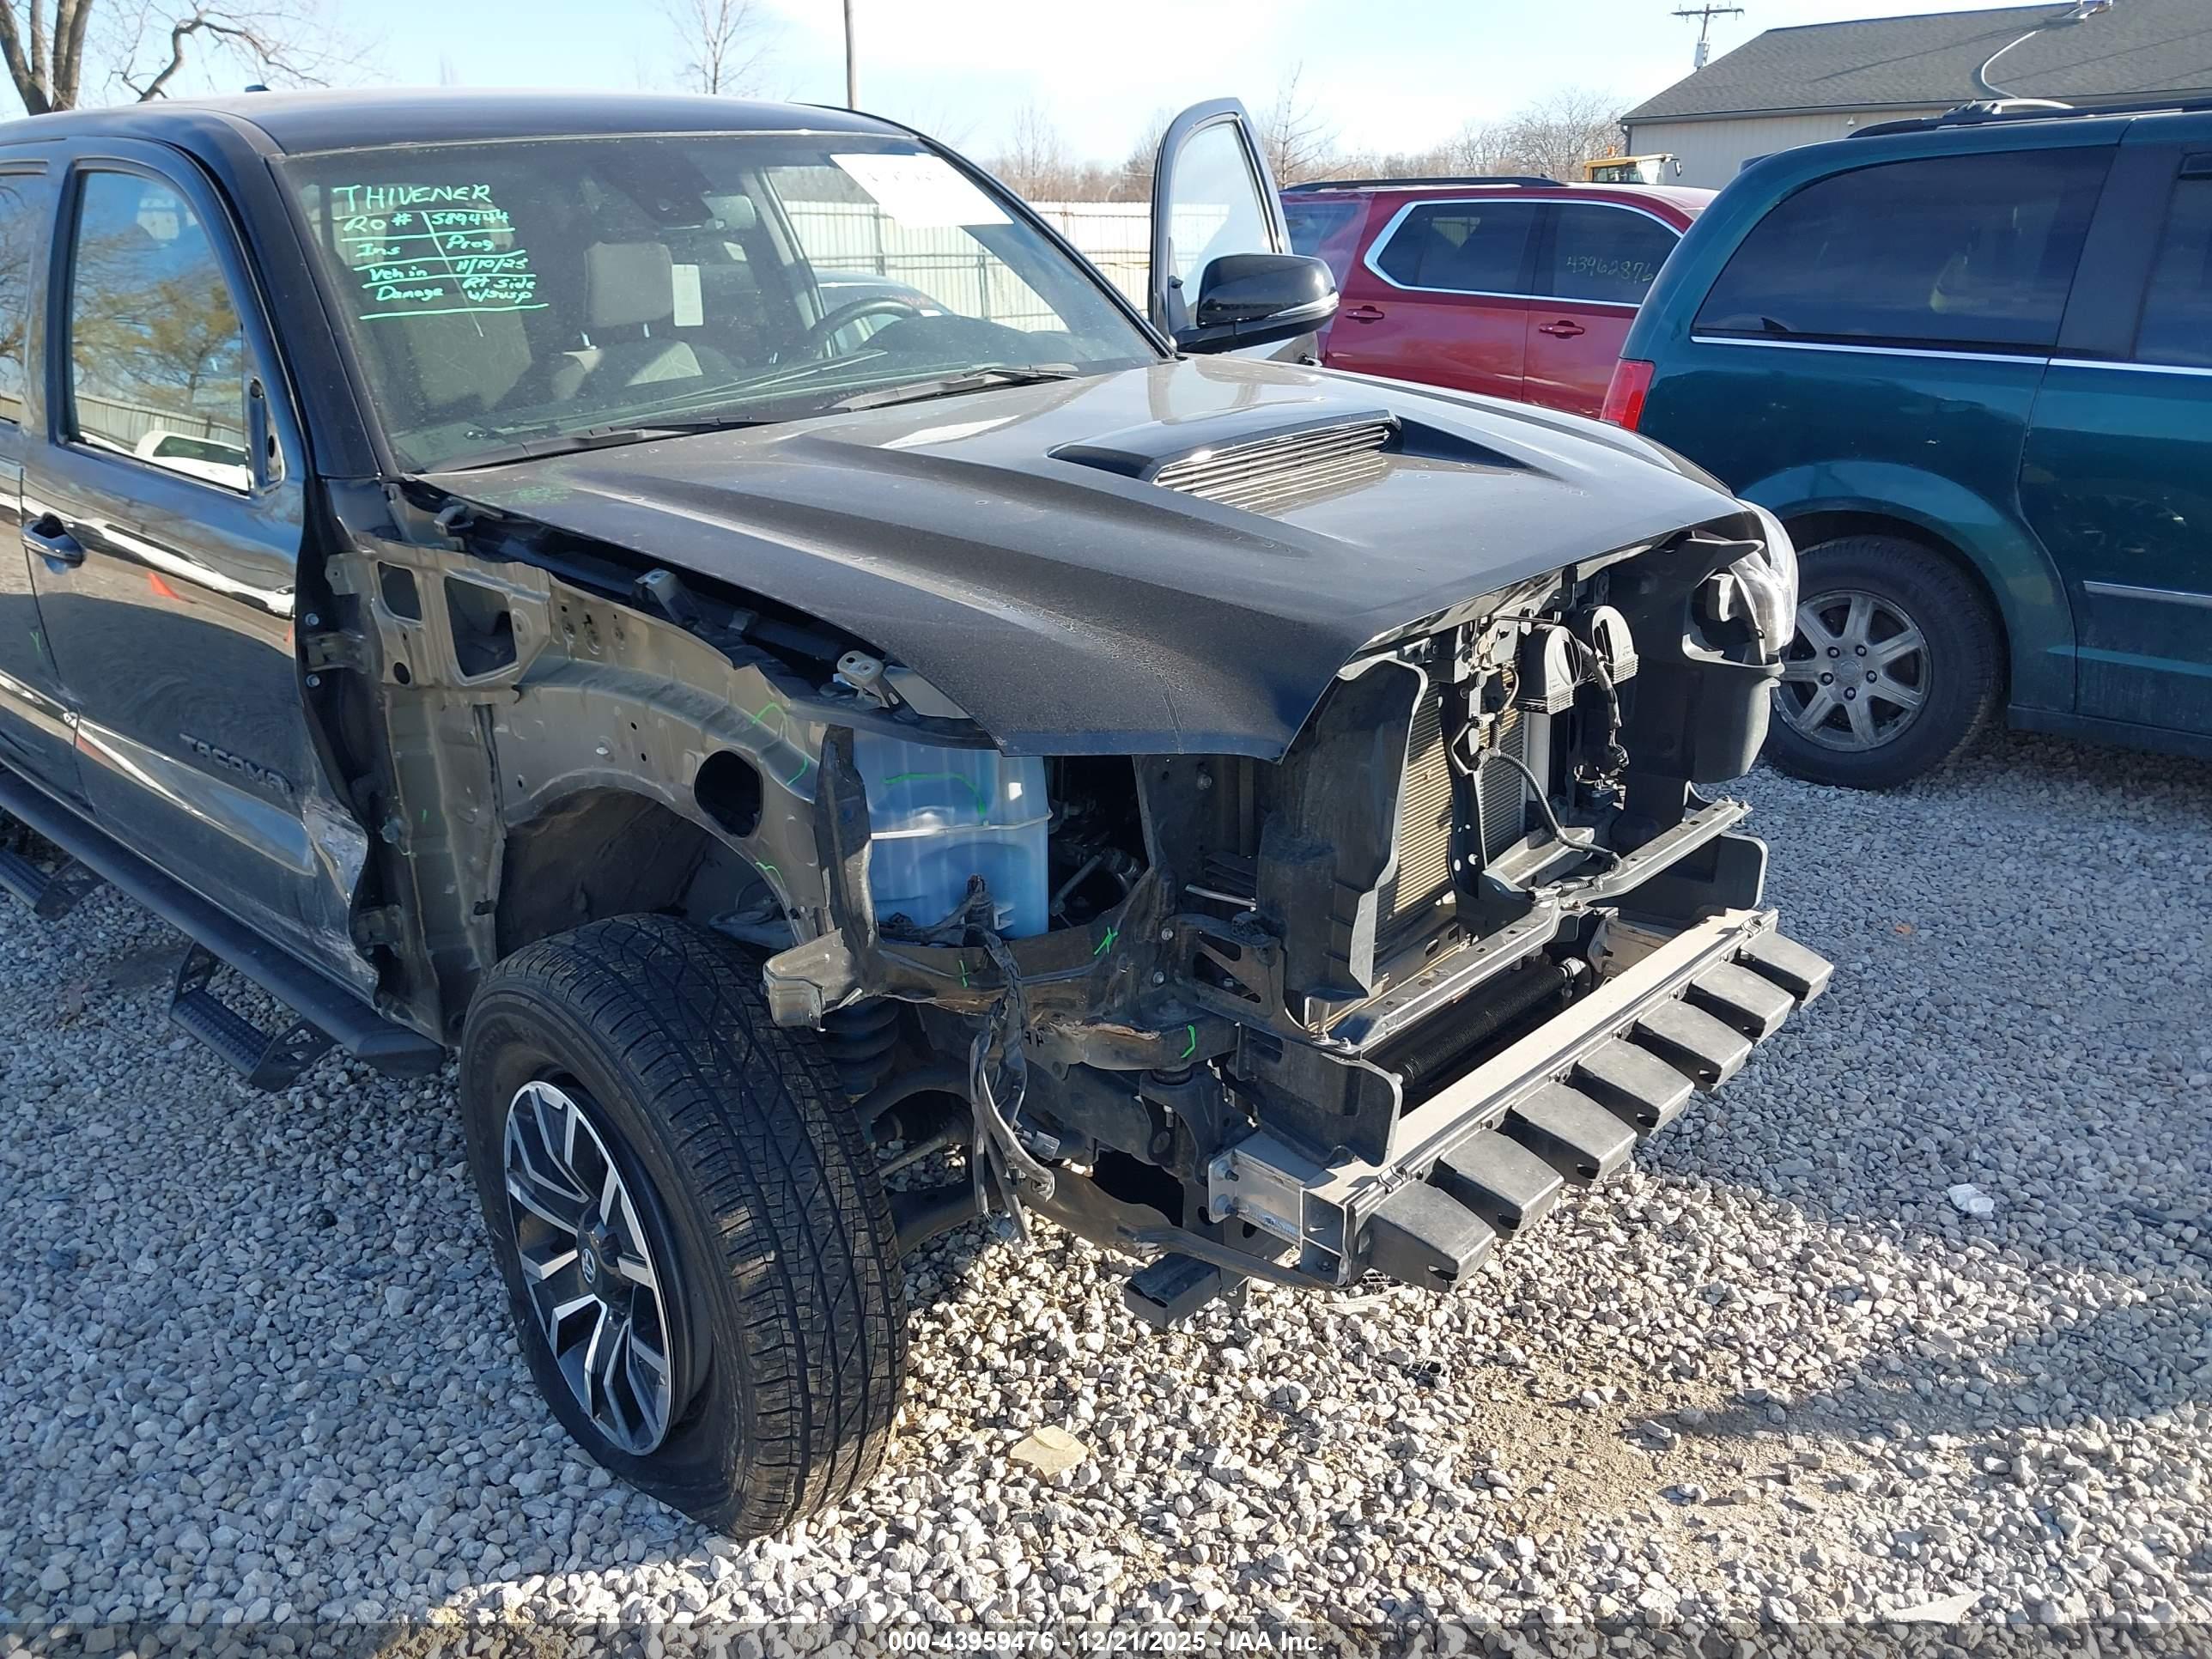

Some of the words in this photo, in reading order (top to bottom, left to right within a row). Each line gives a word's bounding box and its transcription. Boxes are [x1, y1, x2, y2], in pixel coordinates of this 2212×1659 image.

[332, 185, 493, 212] THIVENER
[392, 213, 412, 227] #
[431, 210, 509, 226] 589444
[356, 243, 401, 257] Ins
[446, 234, 495, 252] Prog
[456, 258, 529, 275] 11/10/25
[375, 285, 444, 301] Damage
